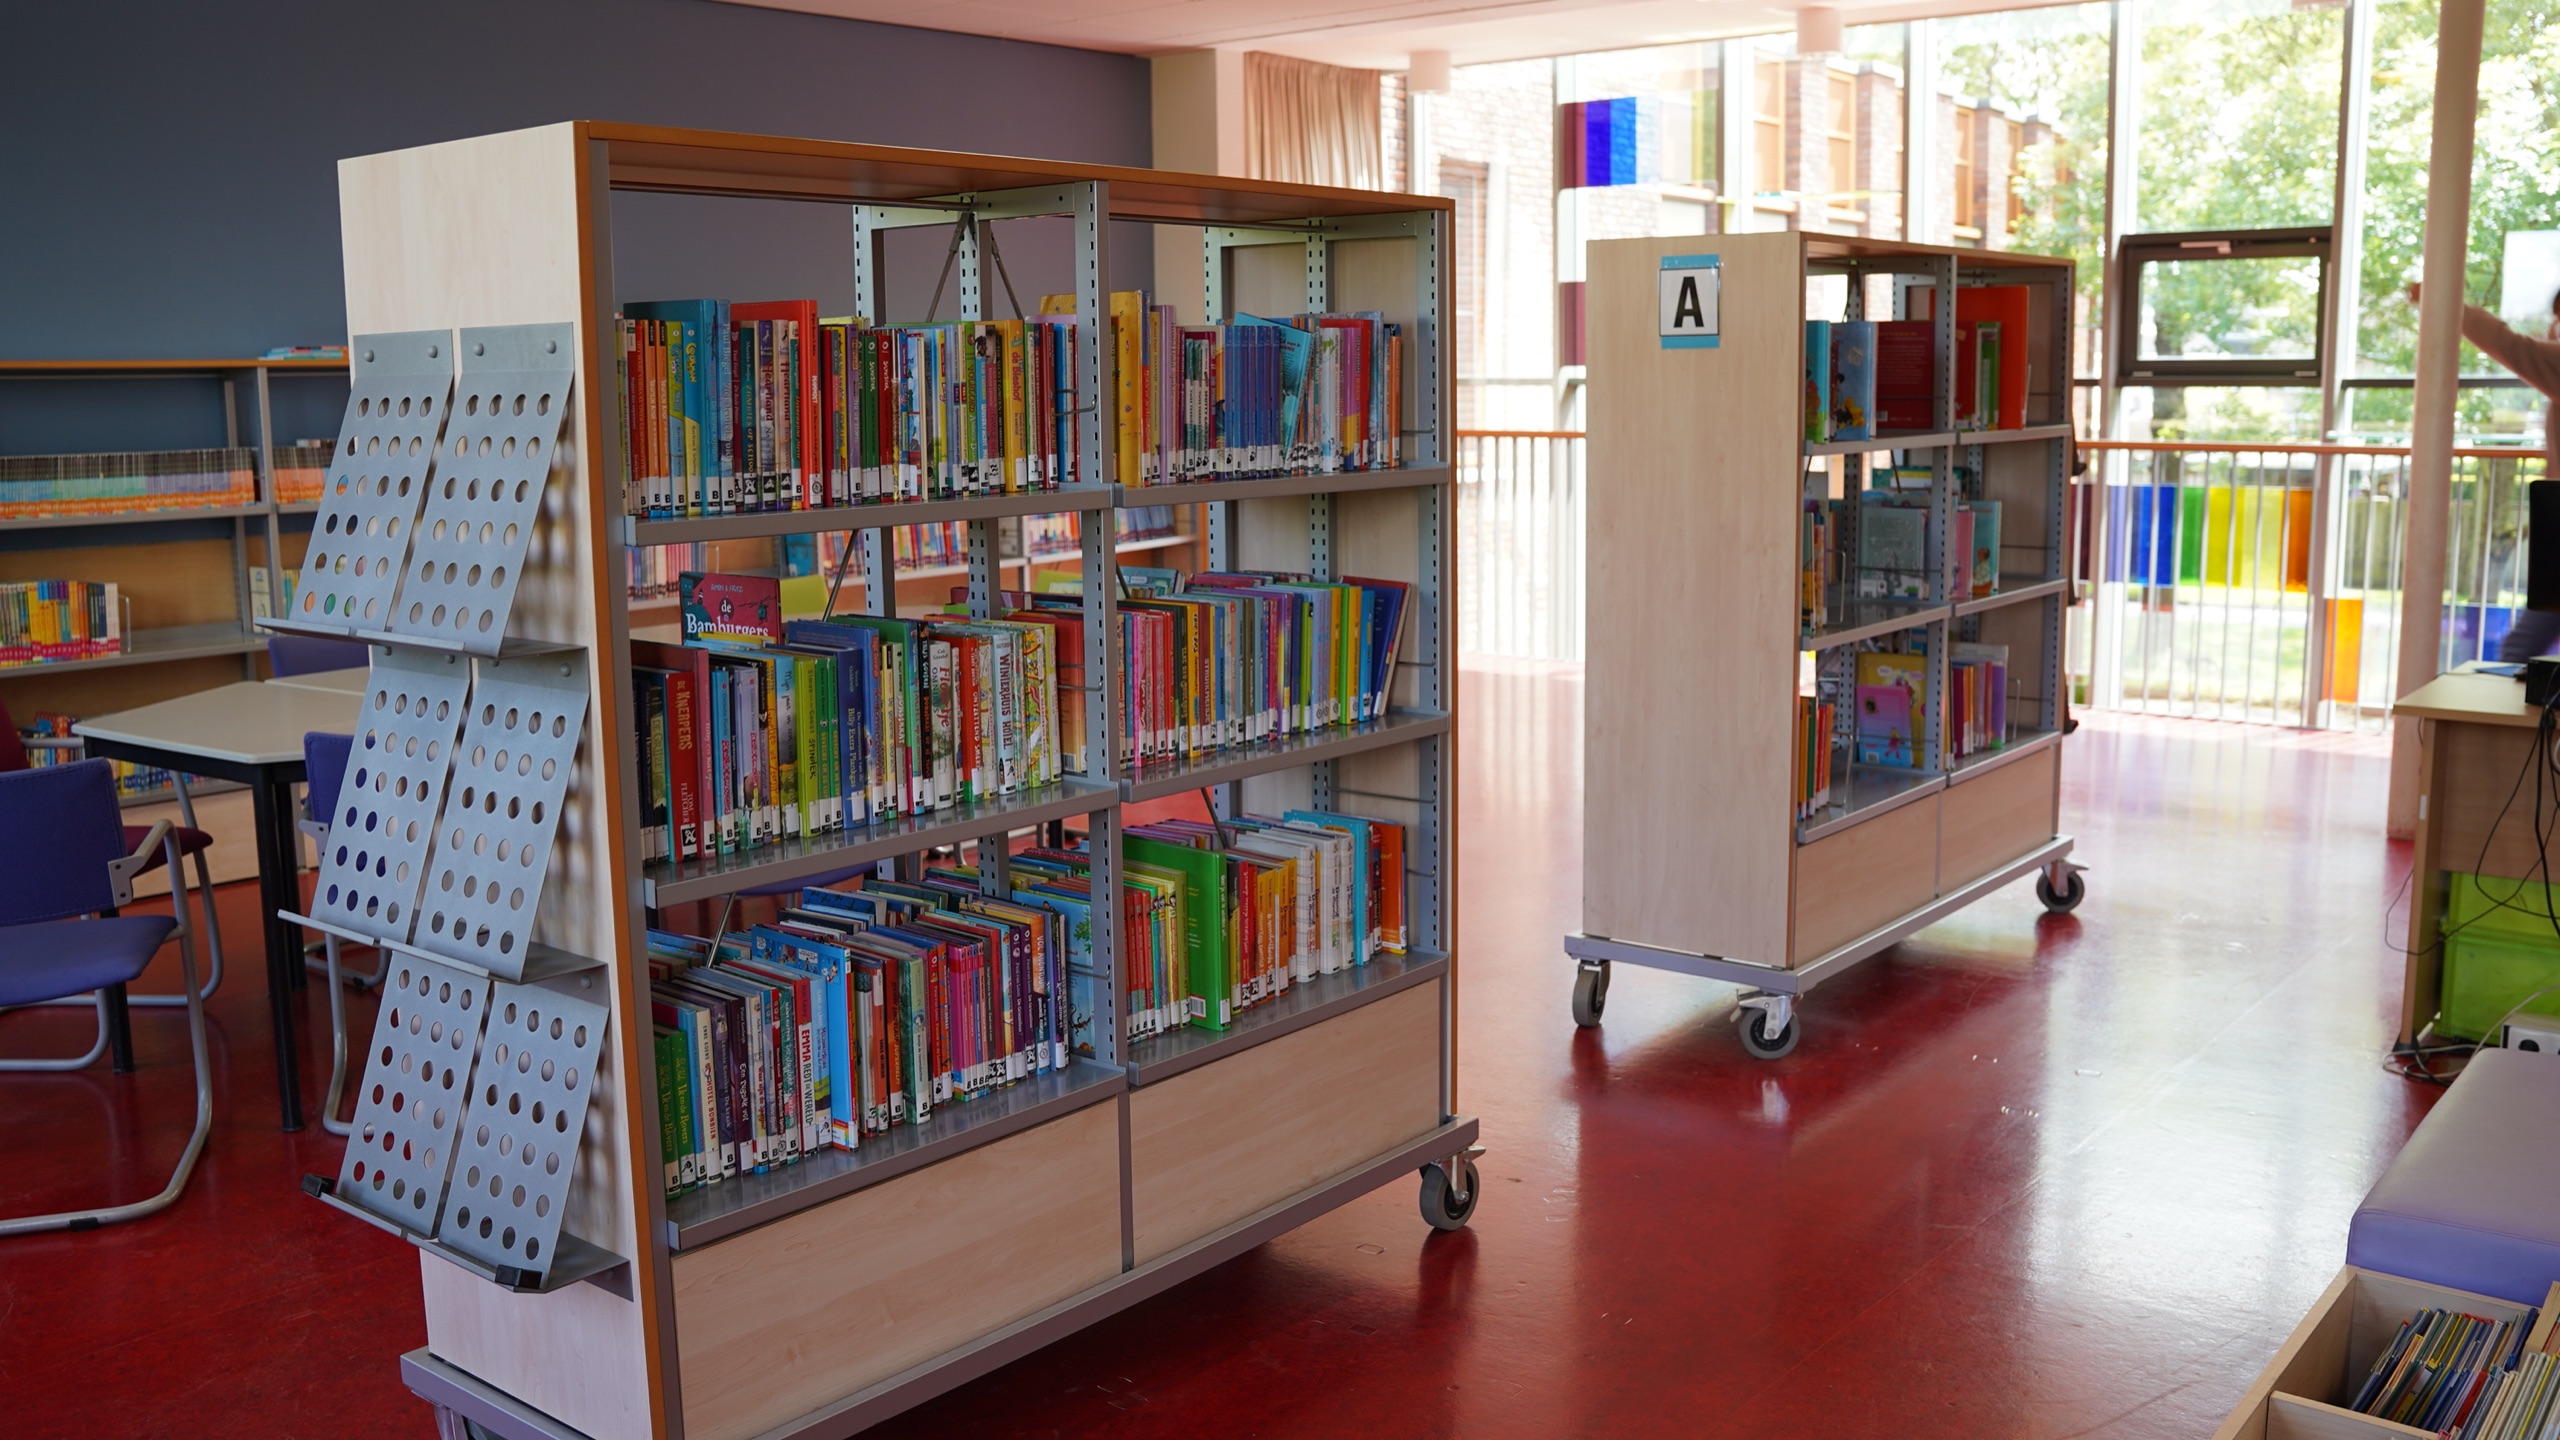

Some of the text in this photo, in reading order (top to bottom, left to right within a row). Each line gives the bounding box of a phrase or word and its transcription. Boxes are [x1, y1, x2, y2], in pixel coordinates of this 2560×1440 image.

[1674, 276, 1704, 328] A
[721, 347, 732, 375] Biegel
[1012, 352, 1019, 364] de
[761, 362, 773, 420] Heartland
[781, 362, 790, 420] Heartland
[854, 400, 859, 410] Na
[747, 429, 753, 440] OP
[712, 491, 718, 499] B
[727, 490, 734, 499] B
[797, 485, 802, 494] B
[641, 497, 647, 505] B
[654, 494, 660, 502] B
[665, 494, 671, 503] B
[678, 495, 684, 503] B
[695, 491, 701, 500] B
[721, 600, 732, 612] de
[686, 613, 768, 636] Bamburgers
[936, 667, 951, 727] Floortje
[999, 654, 1014, 749] WINTERHUIS HOTEL
[676, 681, 692, 750] DE KNERPERS
[857, 712, 861, 720] De
[859, 773, 864, 781] de
[681, 782, 689, 823] FLETCHER
[825, 815, 830, 823] B
[765, 822, 770, 830] B
[727, 829, 732, 838] B
[756, 828, 762, 836] B
[801, 1030, 811, 1062] EMMA
[803, 1064, 812, 1083] REDT
[678, 1084, 687, 1096] Ik
[740, 1080, 748, 1106] rugzak
[661, 1093, 671, 1103] Ik
[725, 1096, 730, 1105] De
[680, 1105, 686, 1113] de
[805, 1090, 814, 1123] WERELD
[680, 1115, 690, 1144] Rovers
[664, 1123, 674, 1152] Rovers
[727, 1154, 733, 1162] B
[761, 1151, 767, 1159] B
[672, 1175, 678, 1184] B
